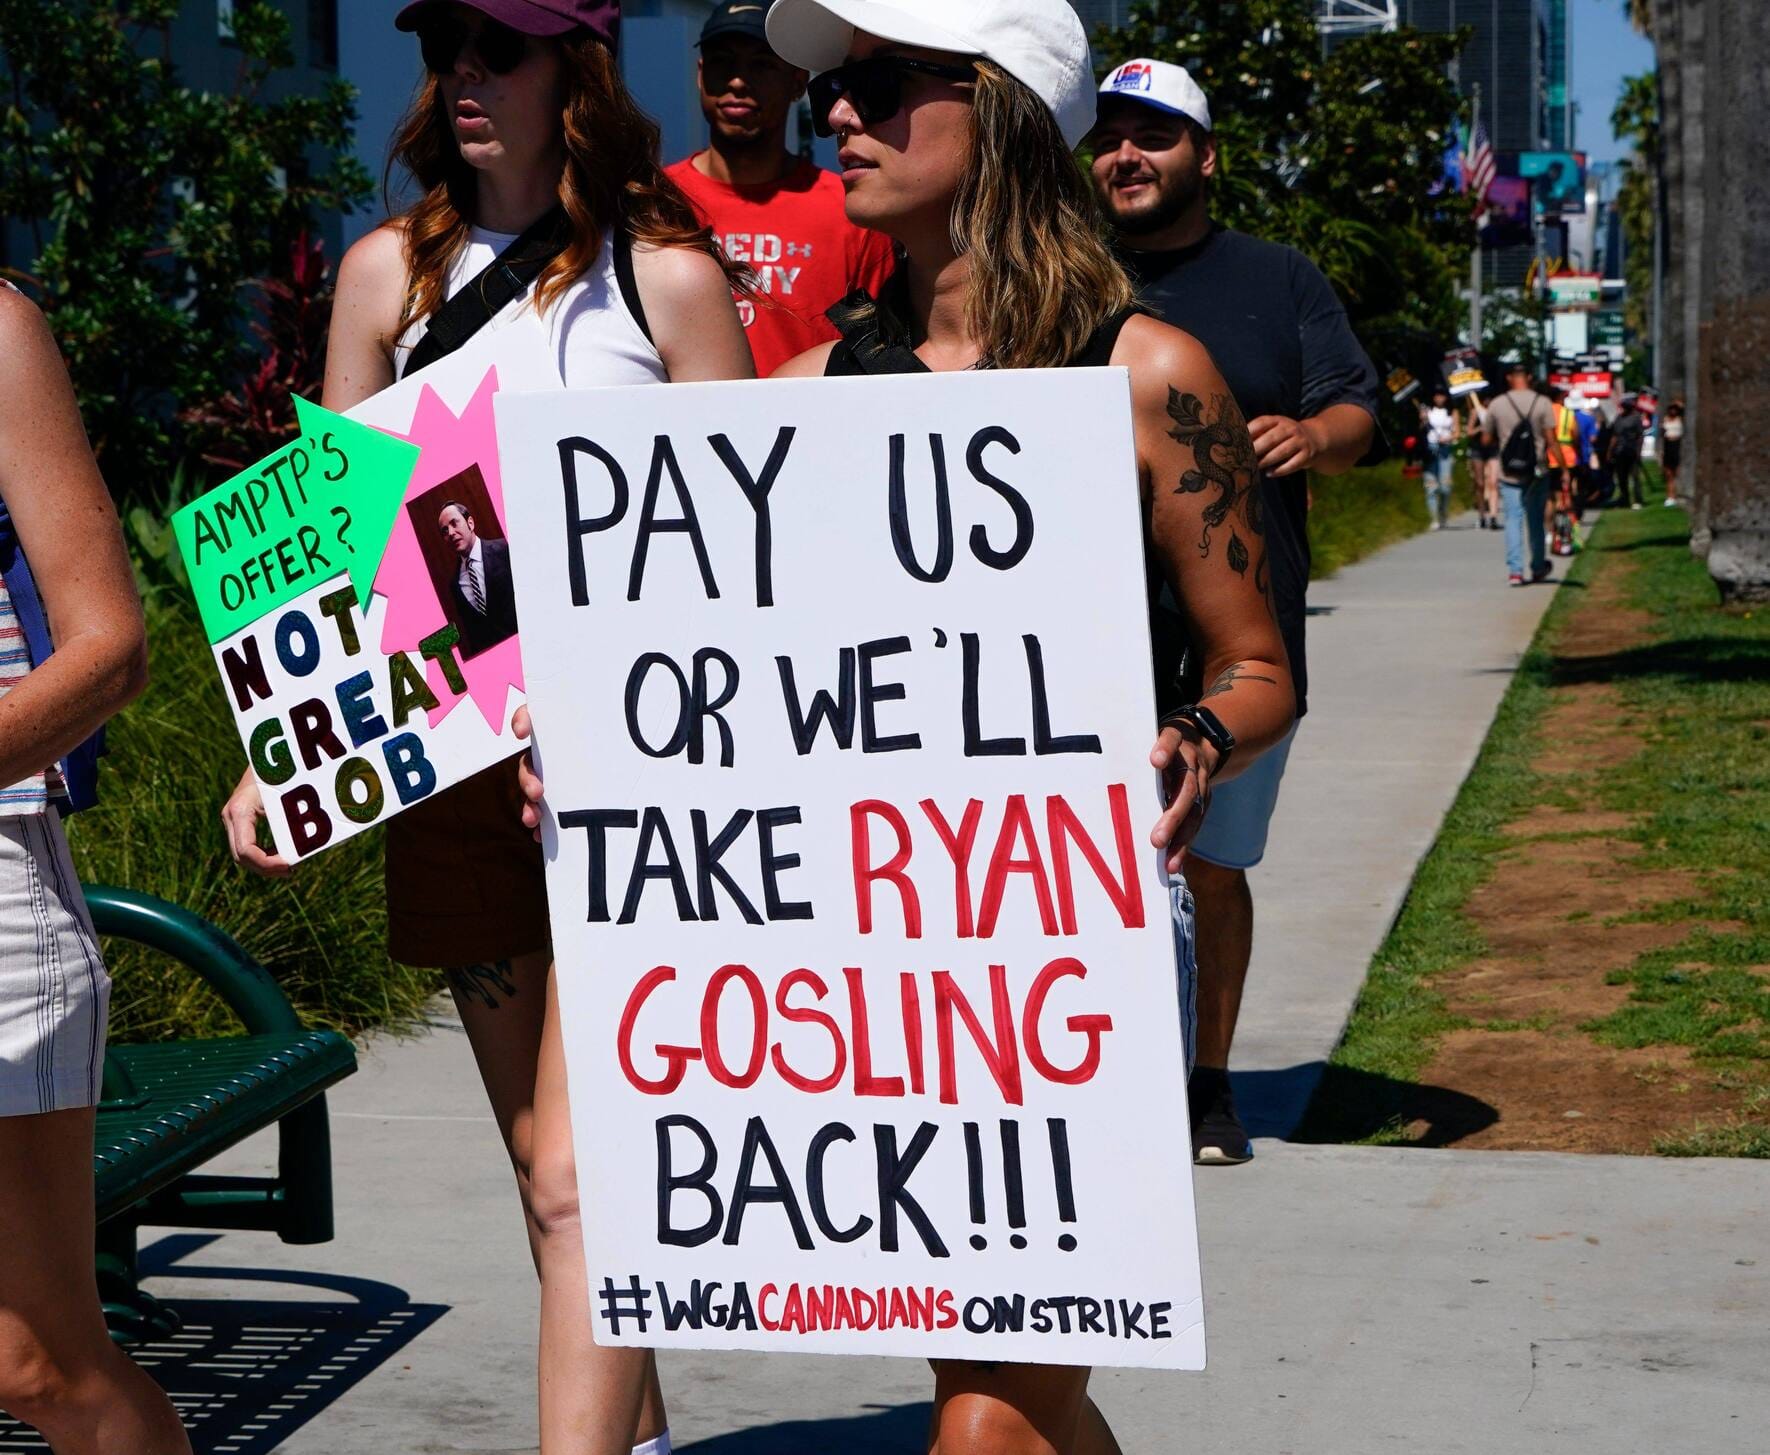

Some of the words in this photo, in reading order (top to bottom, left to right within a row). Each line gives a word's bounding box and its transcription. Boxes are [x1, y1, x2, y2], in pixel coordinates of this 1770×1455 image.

[195, 432, 349, 567] AMPTP'S
[220, 505, 356, 612] OFFER?
[557, 426, 796, 607] PAY
[889, 426, 1034, 583] US
[221, 584, 361, 713] NOT
[249, 622, 468, 786] GREAT
[625, 647, 740, 768] OR
[775, 628, 1102, 757] WE'LL
[280, 732, 437, 858] BOB
[558, 806, 814, 925] TAKE
[850, 783, 1146, 939] RYAN
[617, 958, 1113, 1106] GOSLING
[656, 1114, 1078, 1258] BACK!!!
